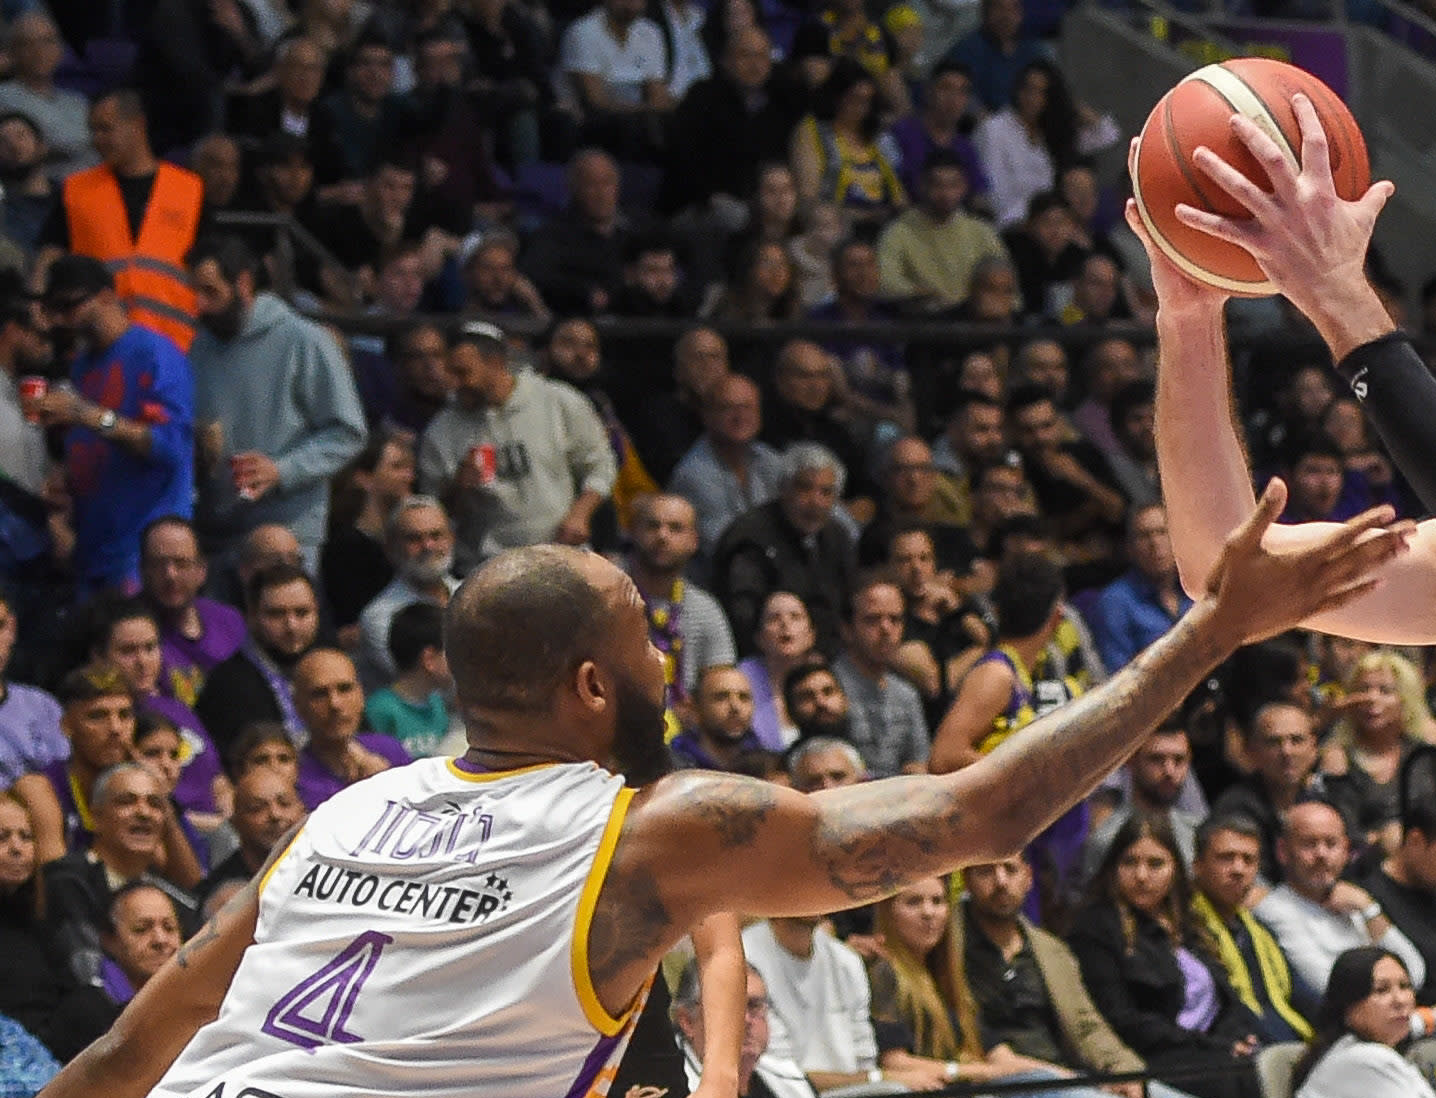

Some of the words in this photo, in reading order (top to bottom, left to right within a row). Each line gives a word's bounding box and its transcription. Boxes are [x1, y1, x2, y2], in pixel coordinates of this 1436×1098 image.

[294, 863, 380, 907] AUTO
[377, 879, 500, 925] CENTER
[261, 929, 394, 1056] 4
